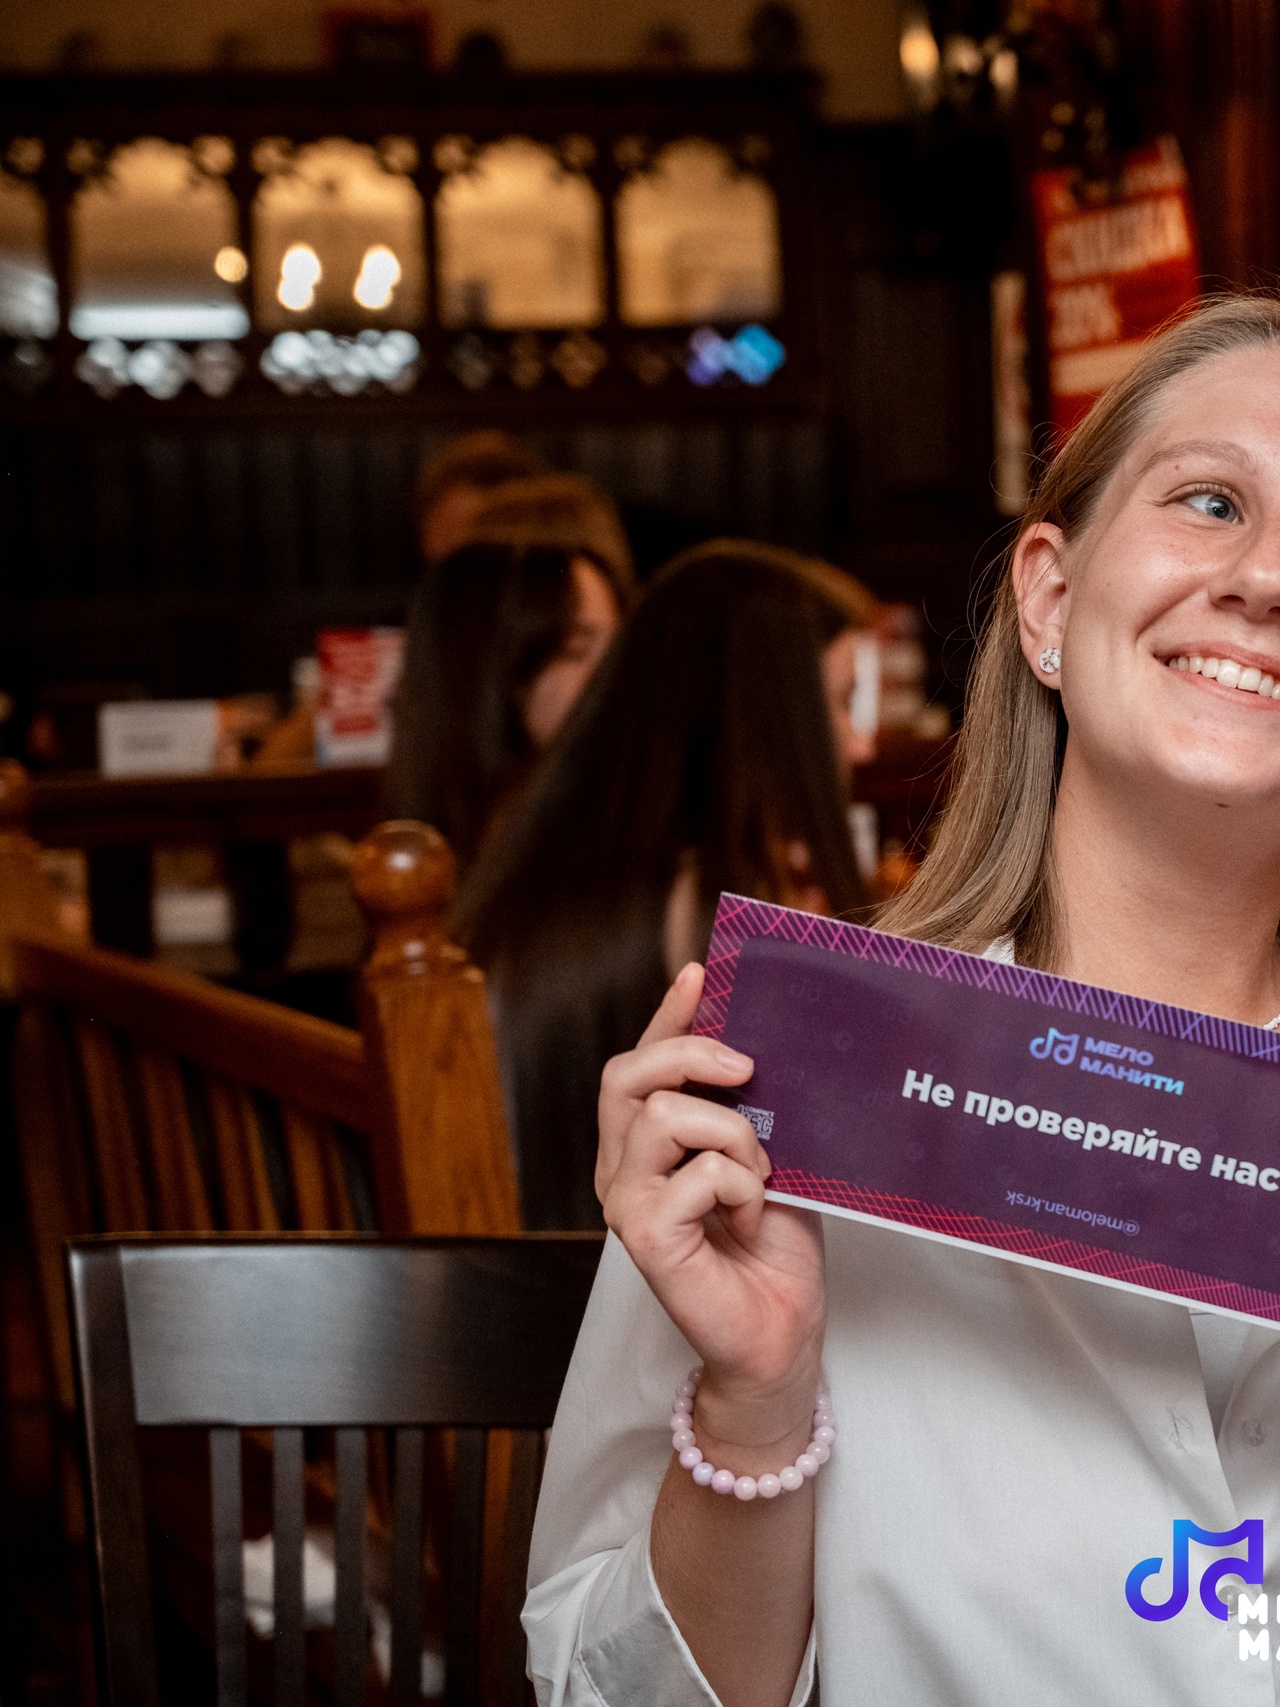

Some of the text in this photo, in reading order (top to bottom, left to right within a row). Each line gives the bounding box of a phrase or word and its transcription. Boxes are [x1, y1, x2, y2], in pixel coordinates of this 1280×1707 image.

[1084, 1037, 1154, 1066] МЕЛО
[1079, 1056, 1185, 1096] МАНИТИ
[902, 1068, 955, 1107] Не
[963, 1090, 1202, 1171] проверяйте
[1006, 1190, 1141, 1237] @meloman.krsk
